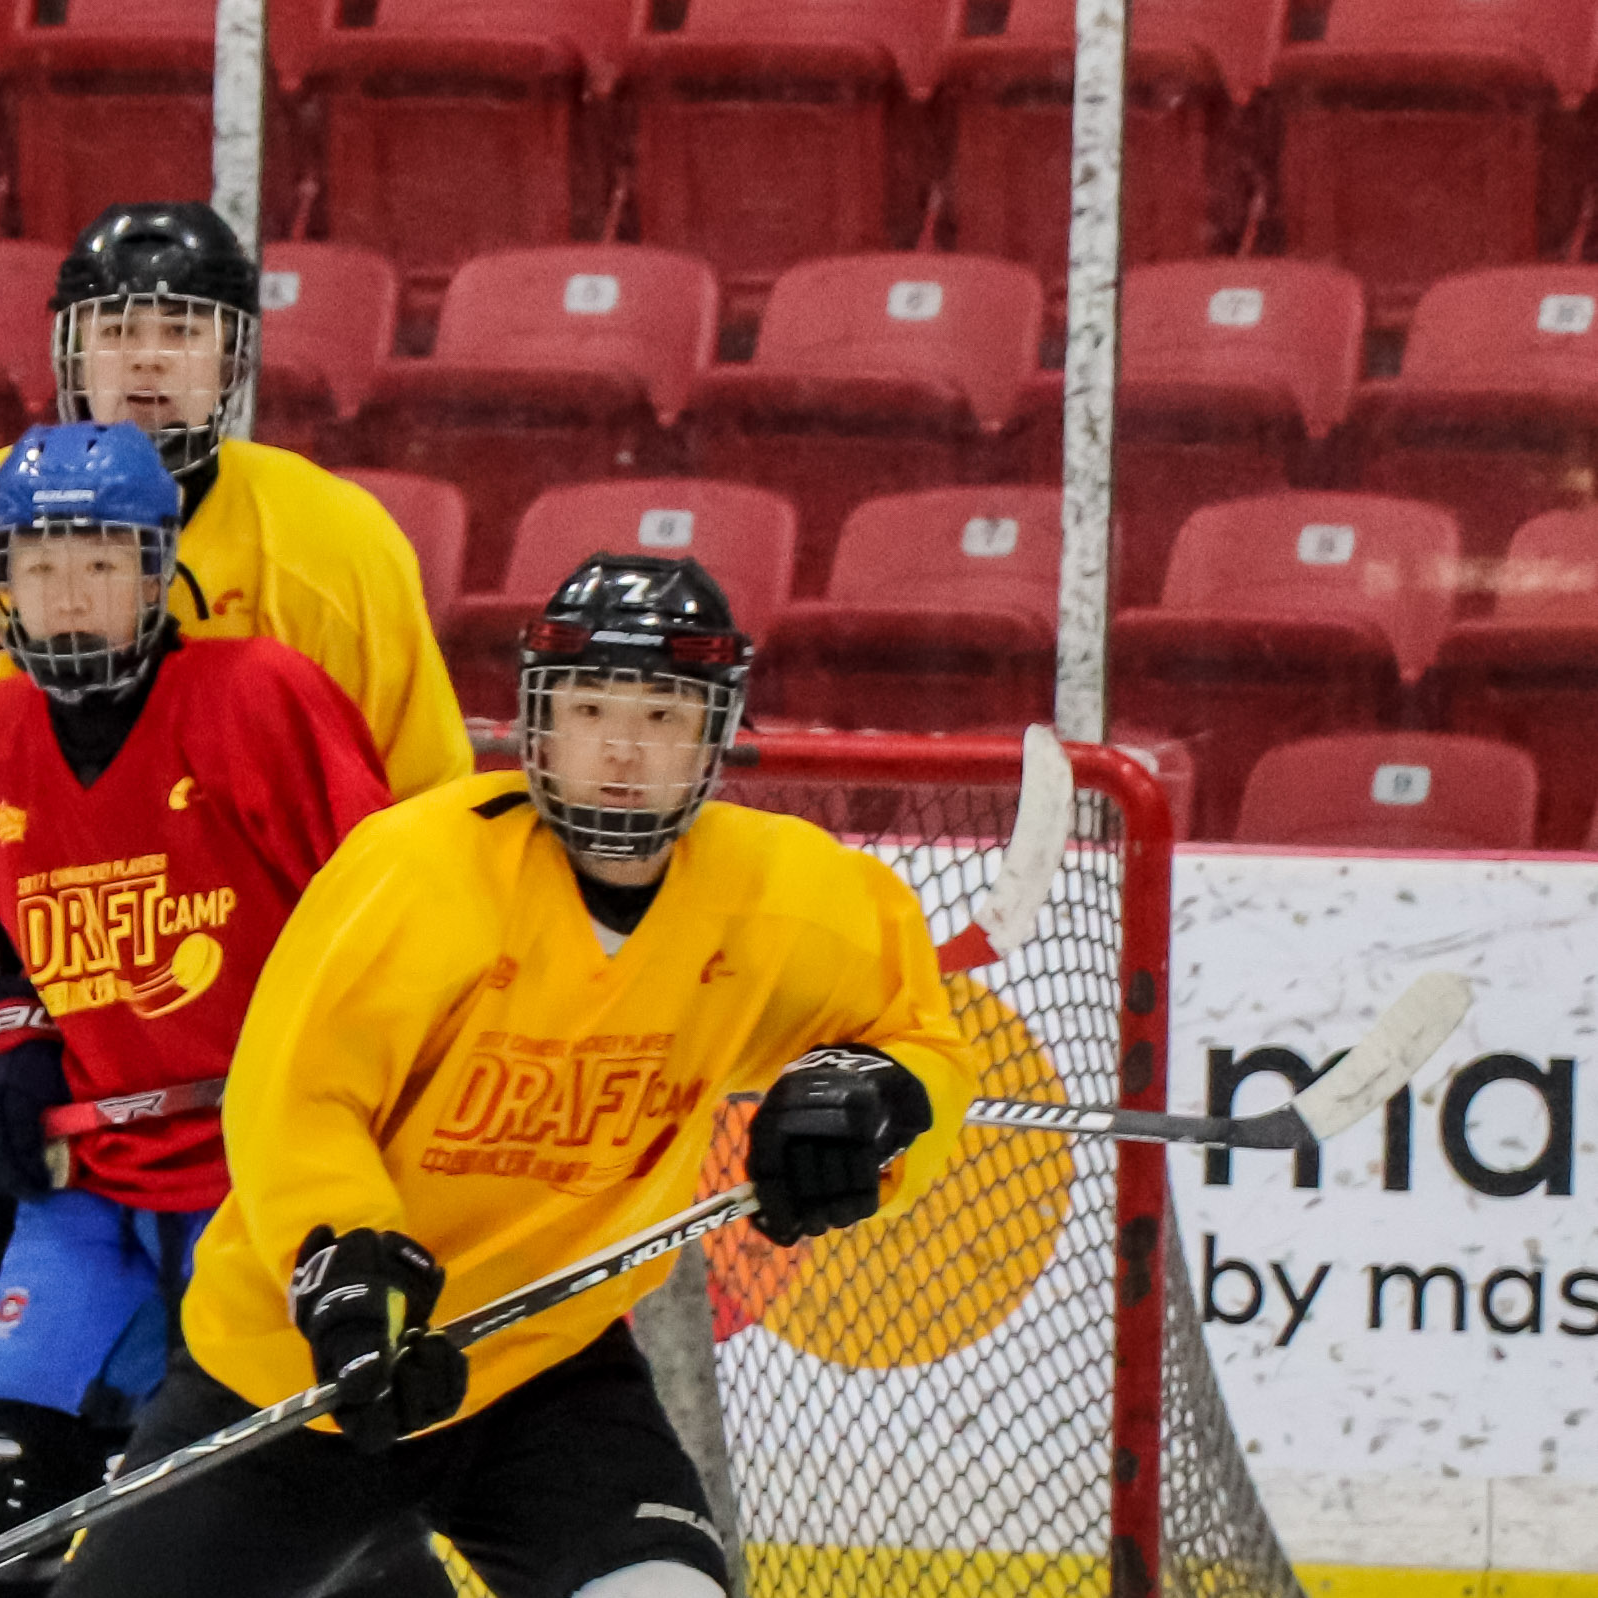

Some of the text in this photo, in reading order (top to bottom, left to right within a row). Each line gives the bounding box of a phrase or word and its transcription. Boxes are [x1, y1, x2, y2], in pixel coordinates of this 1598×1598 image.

[157, 886, 237, 937] CAMP
[433, 1053, 668, 1147] DRAFT
[1203, 1233, 1332, 1346] by
